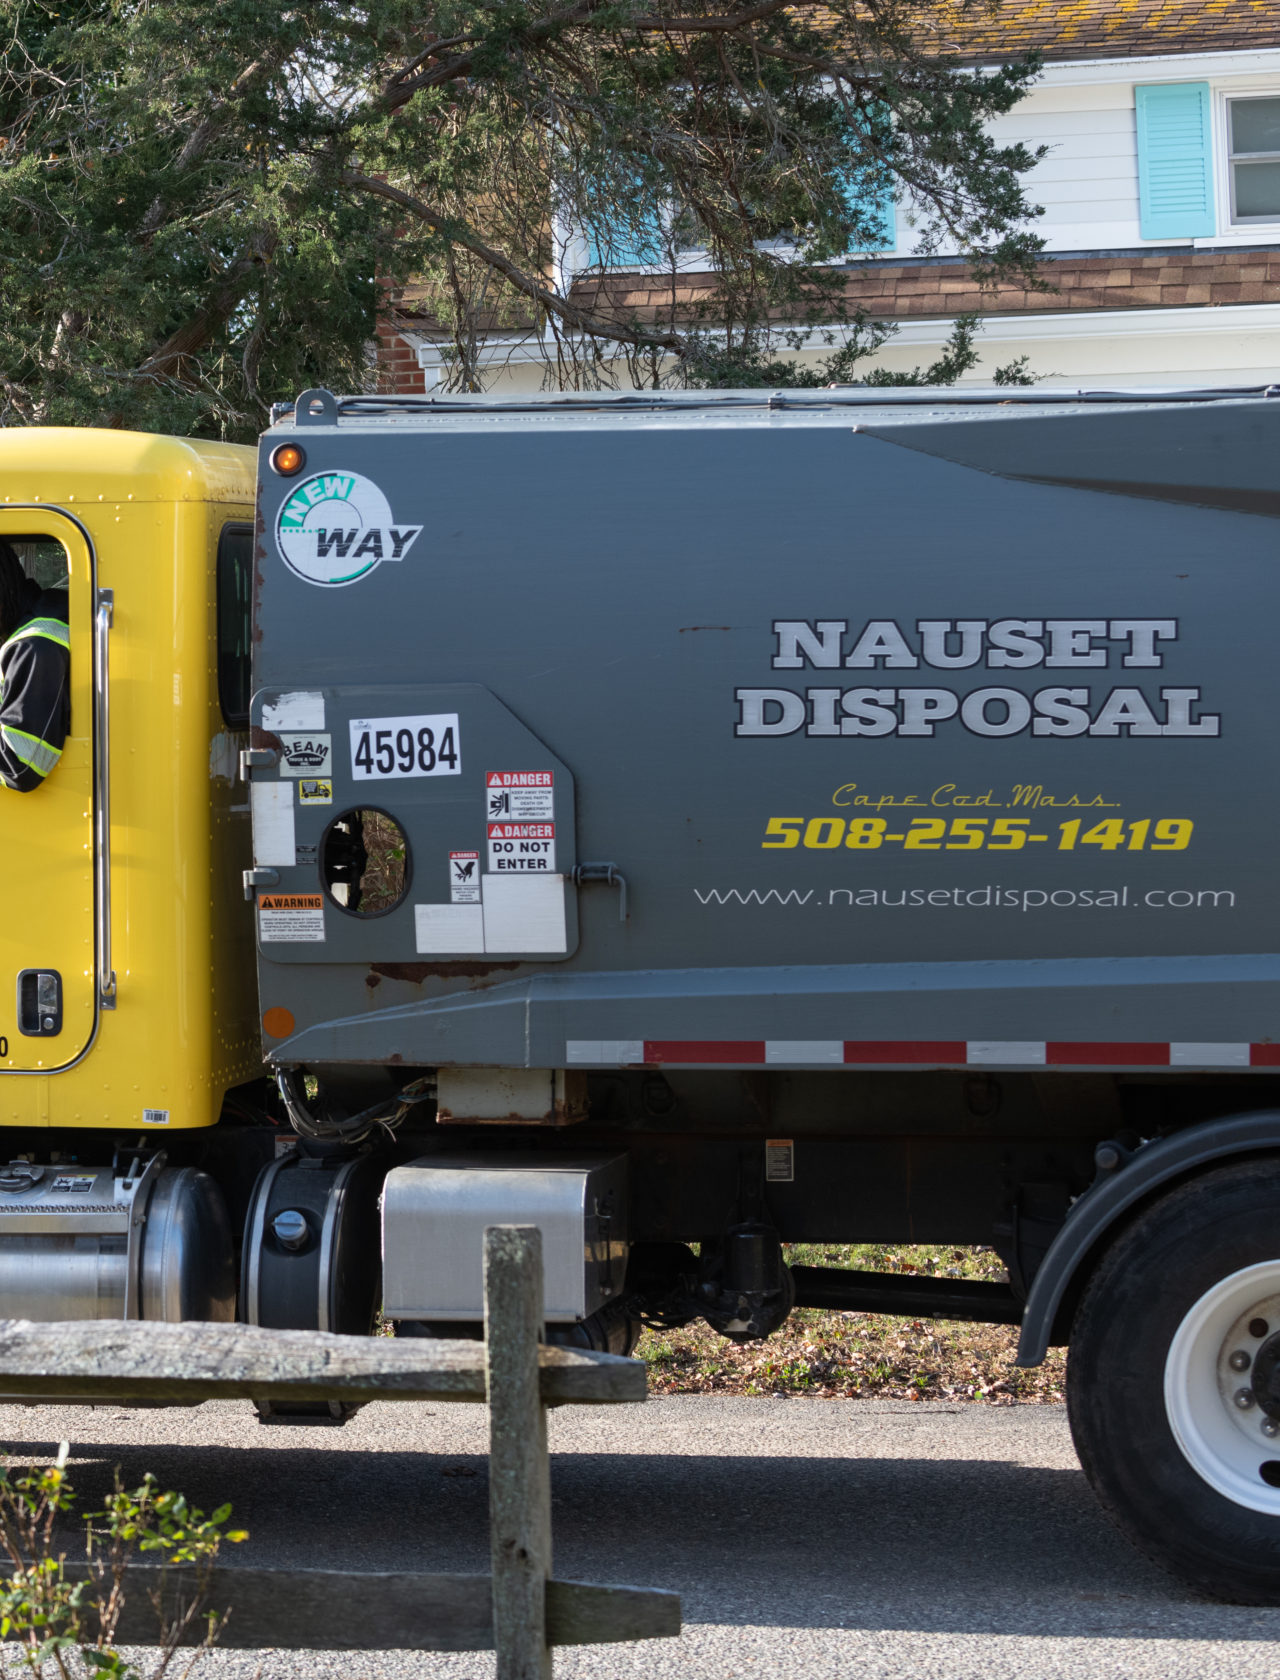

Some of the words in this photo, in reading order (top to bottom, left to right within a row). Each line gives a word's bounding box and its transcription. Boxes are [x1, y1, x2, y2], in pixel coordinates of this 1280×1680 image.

[284, 477, 351, 523] NEW
[317, 528, 419, 558] WAY
[772, 618, 1178, 670] NAUSET
[733, 685, 1221, 738] DISPOSAL
[283, 740, 329, 757] BEAM
[354, 726, 458, 774] 45984
[503, 773, 551, 785] DANGER
[832, 783, 928, 812] Cape
[504, 825, 553, 837] DANGER
[761, 817, 1194, 851] 508-255-1419
[493, 842, 514, 853] DO
[520, 842, 550, 853] NOT
[497, 858, 547, 869] ENTER
[273, 897, 321, 908] WARNING
[694, 885, 1235, 912] www.nausetdisposal.com
